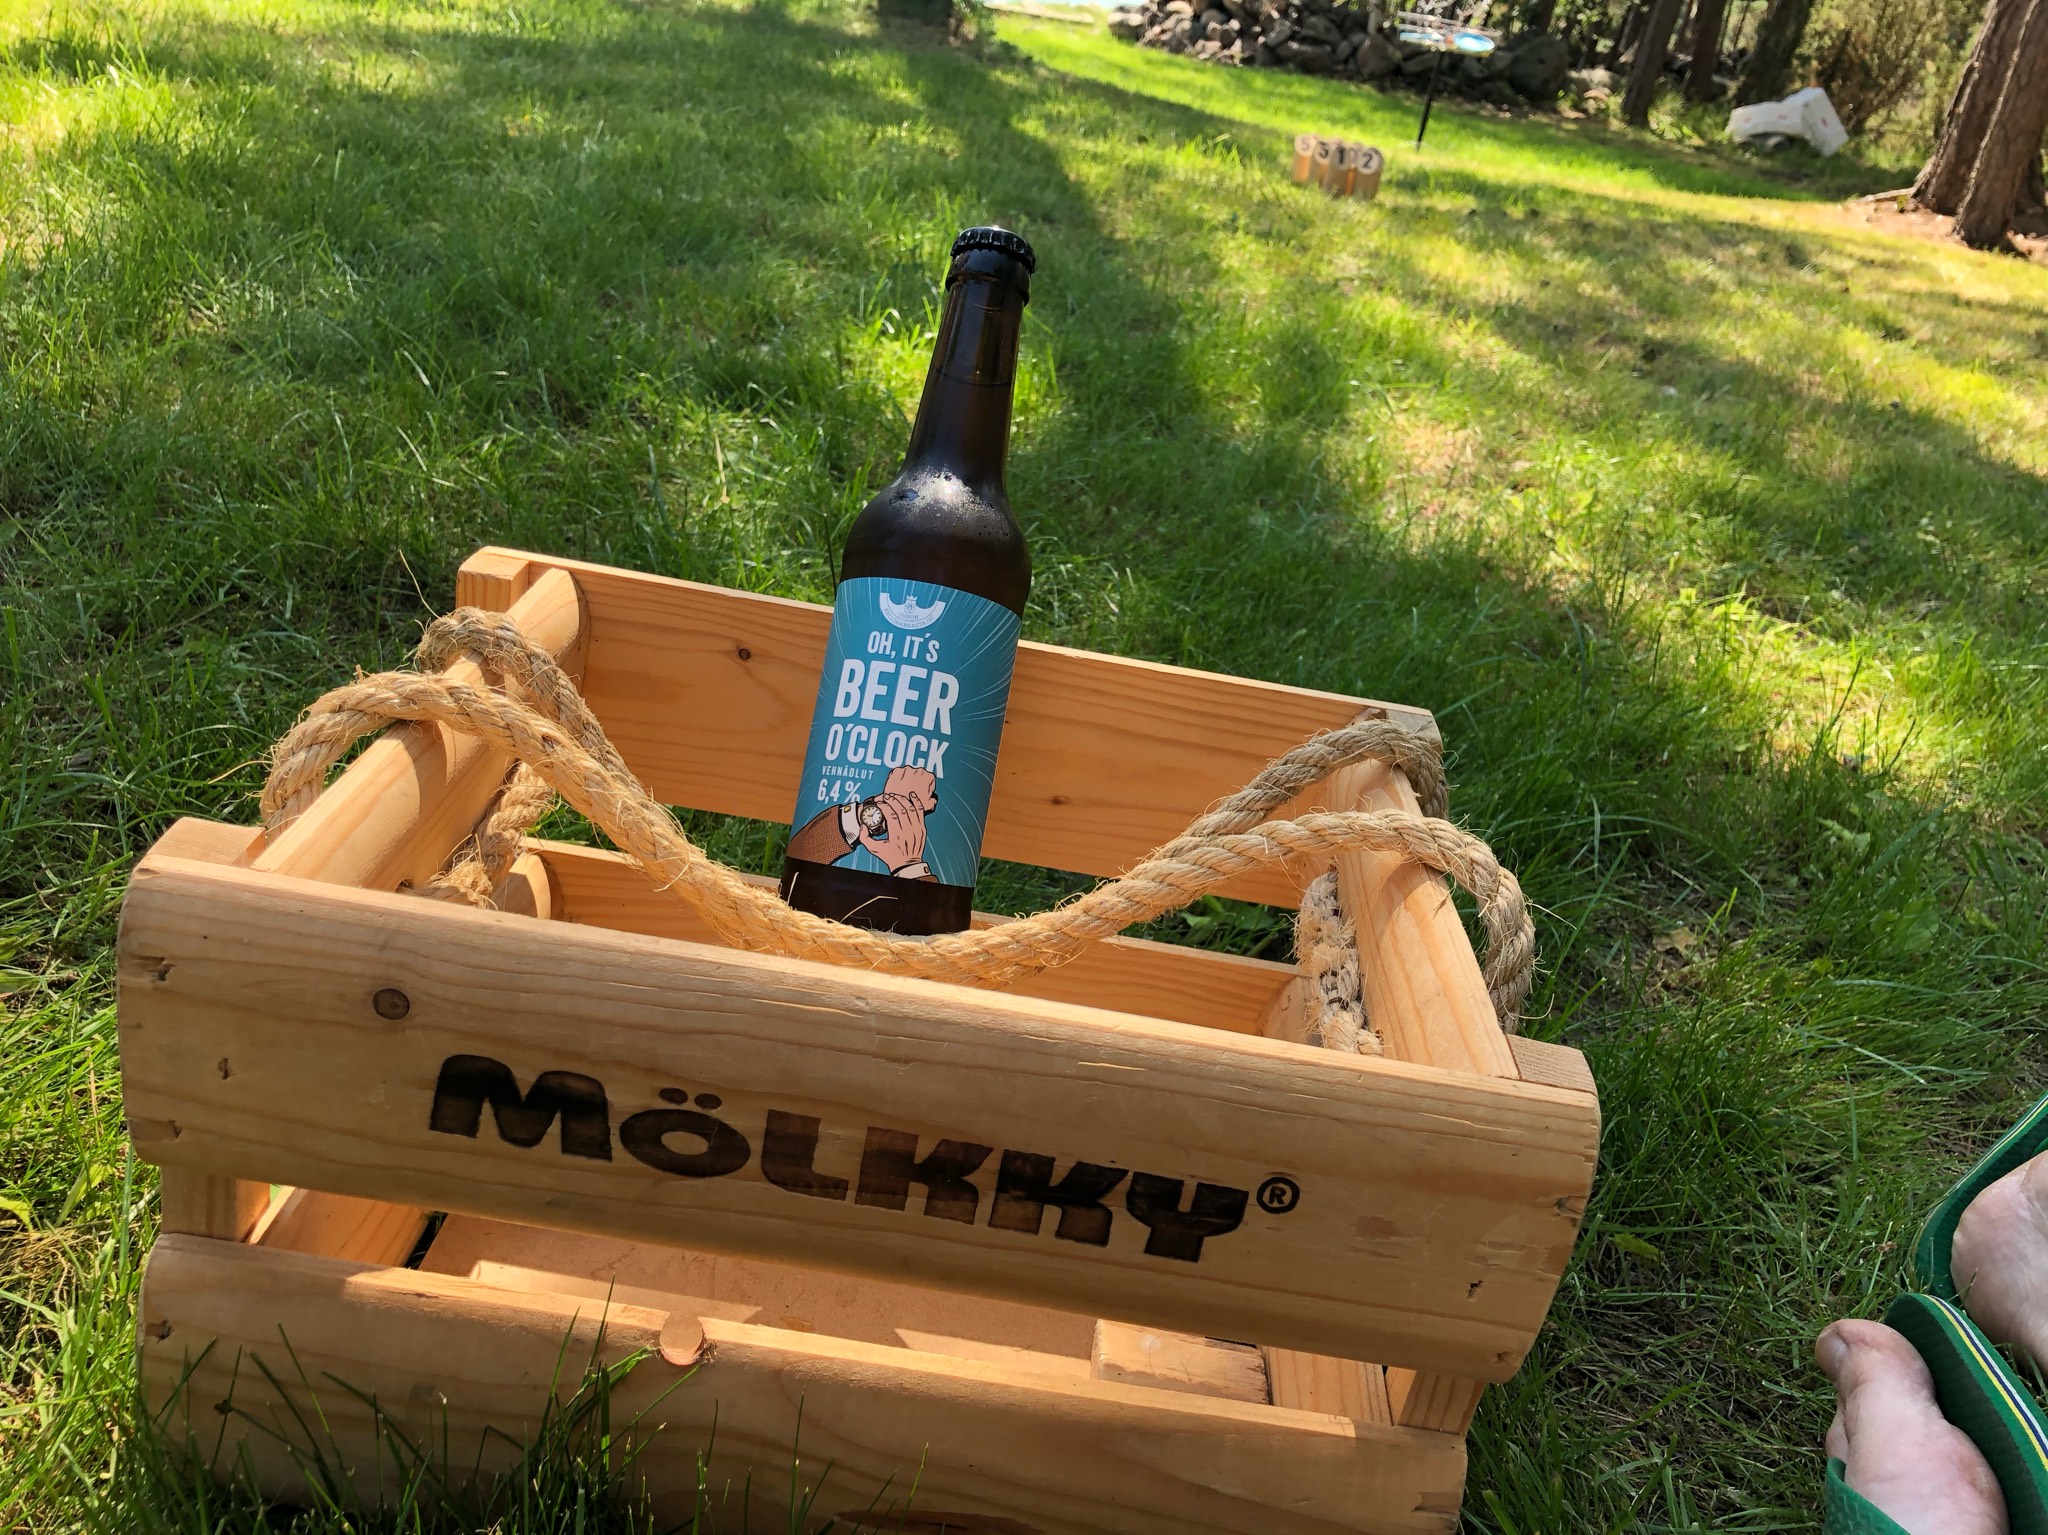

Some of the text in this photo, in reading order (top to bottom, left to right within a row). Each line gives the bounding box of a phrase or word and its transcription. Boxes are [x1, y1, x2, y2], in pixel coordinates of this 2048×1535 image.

[1335, 144, 1346, 165] 1
[1361, 152, 1373, 169] 2
[867, 631, 940, 663] OH, IT'S
[833, 658, 960, 736] BEER
[825, 723, 950, 780] O'CLOCK
[822, 765, 874, 781] VEHNÄOLUT
